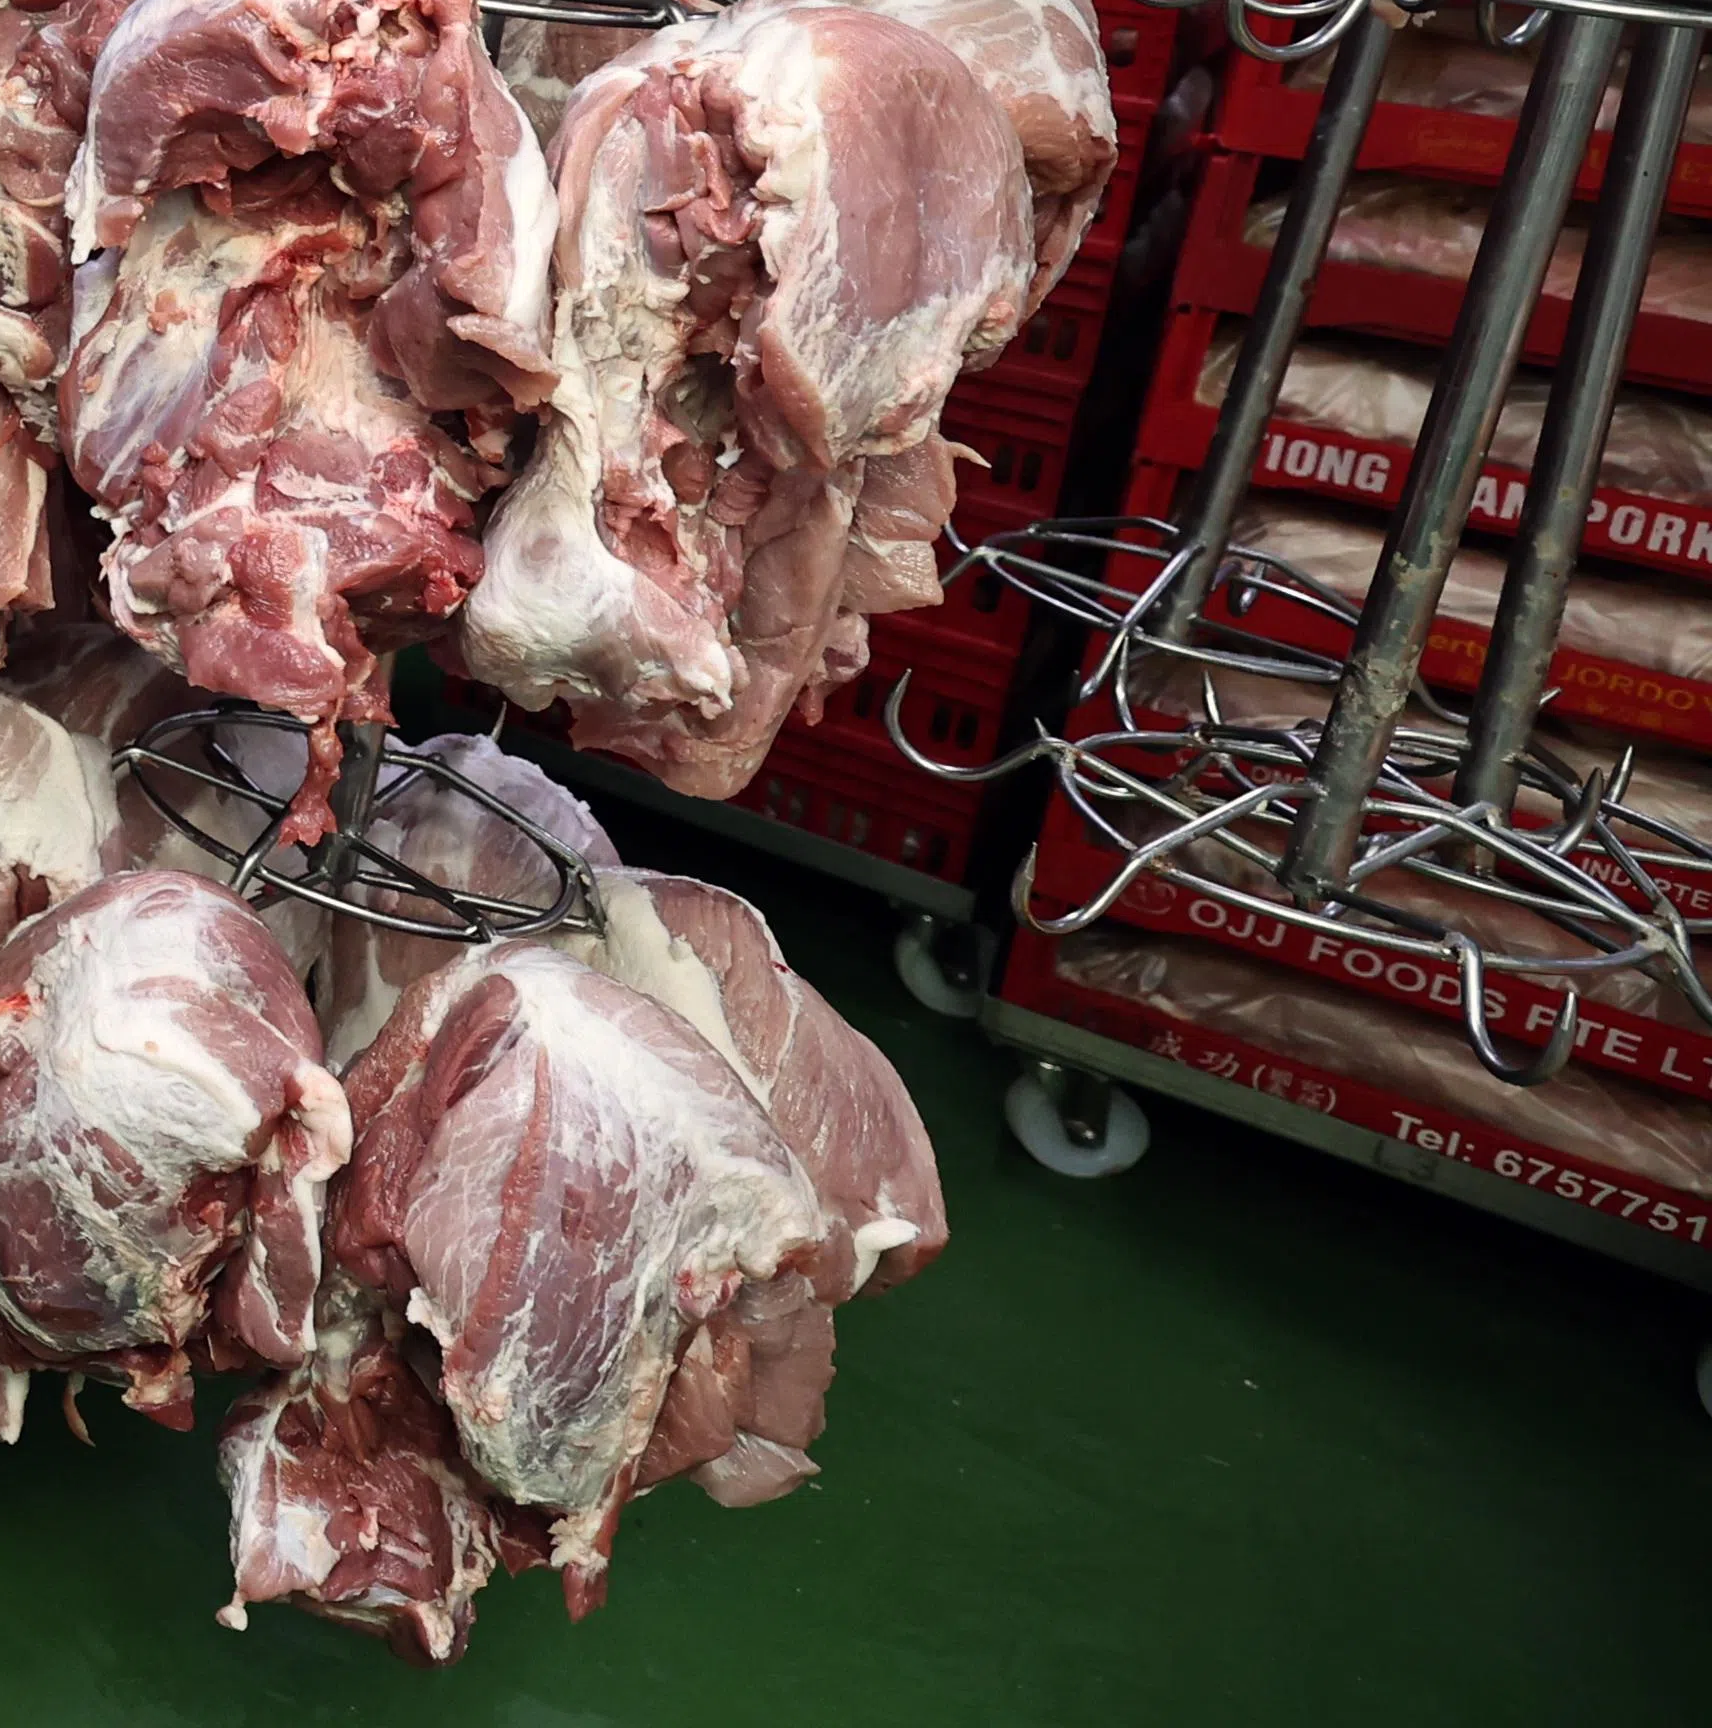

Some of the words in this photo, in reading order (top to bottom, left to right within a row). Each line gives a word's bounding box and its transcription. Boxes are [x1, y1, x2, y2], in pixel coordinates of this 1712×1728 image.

[1263, 433, 1391, 494] IONG
[1188, 899, 1286, 948] OJJ
[1308, 935, 1508, 1020] FOODS
[1525, 1003, 1643, 1064] PTE
[1391, 1110, 1475, 1163] Tel:
[1493, 1149, 1708, 1243] 6757751
